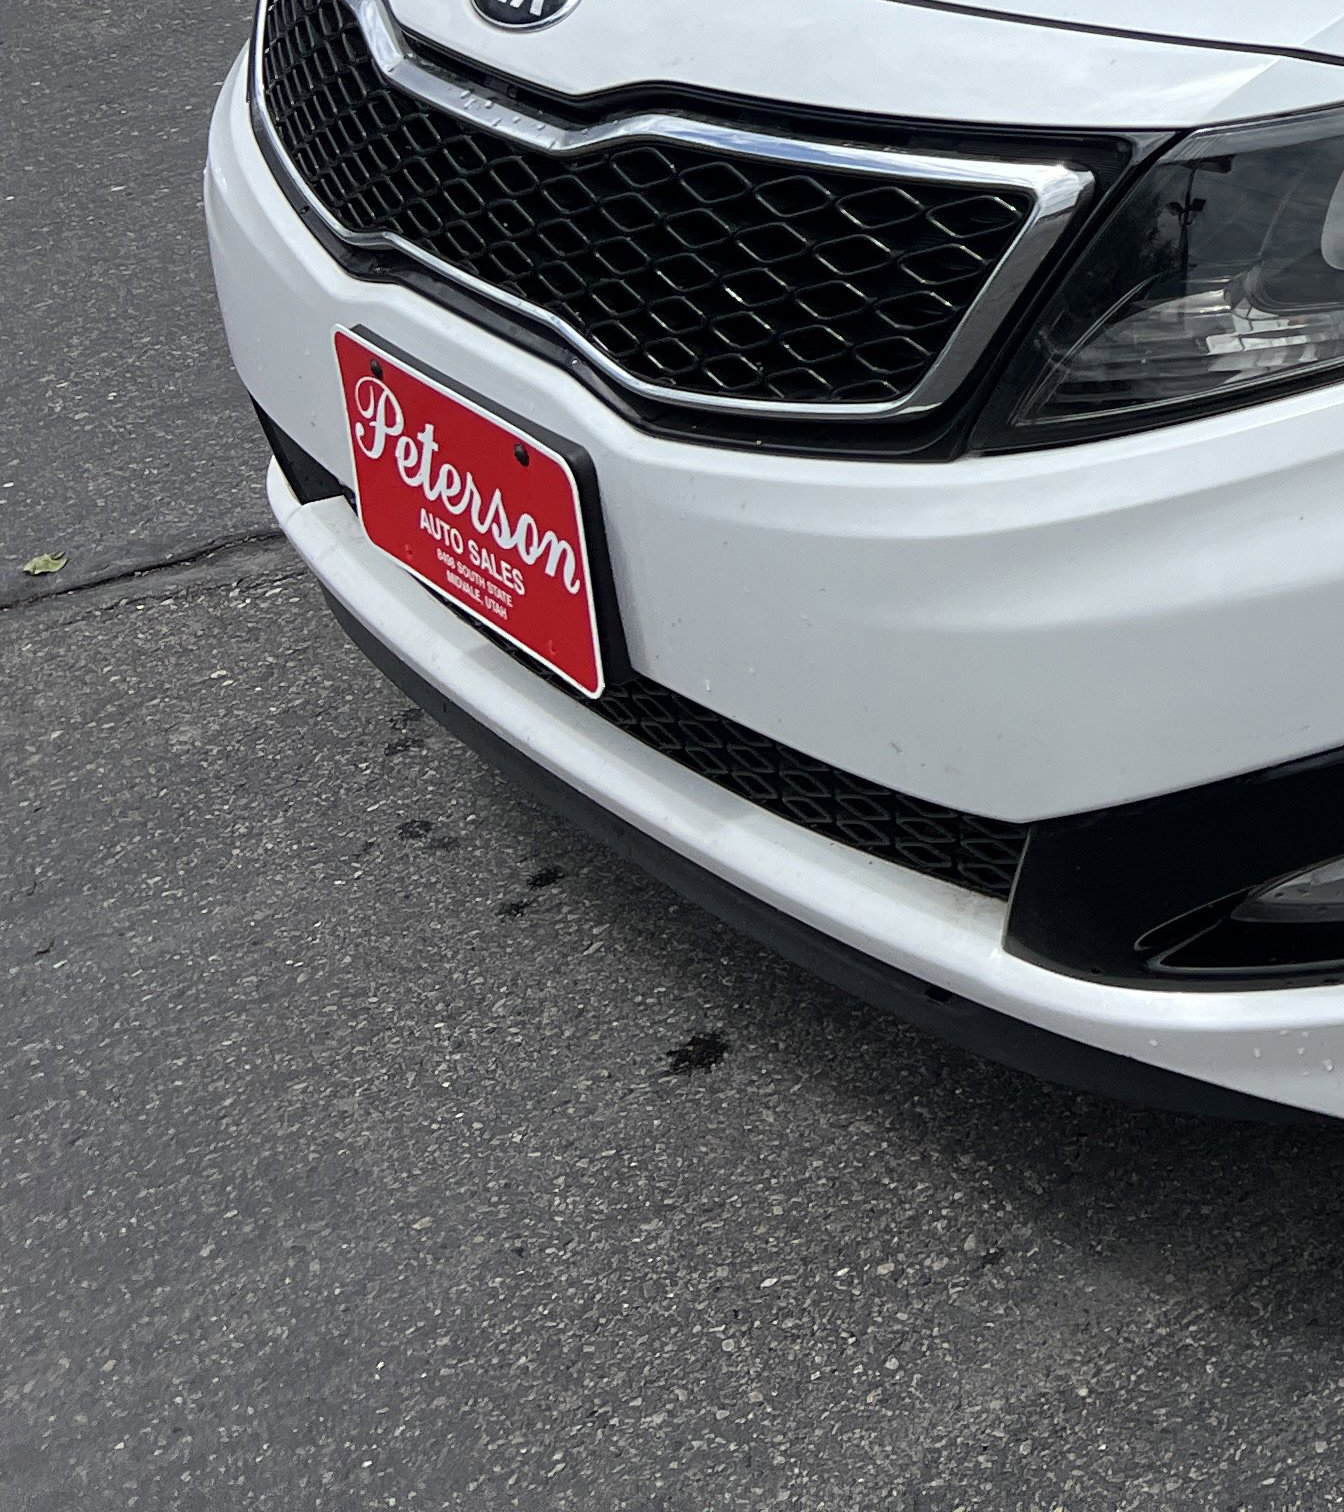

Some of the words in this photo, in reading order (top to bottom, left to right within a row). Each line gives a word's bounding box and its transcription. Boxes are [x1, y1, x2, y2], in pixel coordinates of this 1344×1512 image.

[355, 376, 581, 595] Peterson
[420, 508, 463, 555] AUTO
[468, 539, 526, 596] SALES
[457, 560, 486, 589] SOUTH
[486, 580, 513, 608] STATE
[484, 595, 508, 620] UTAH
